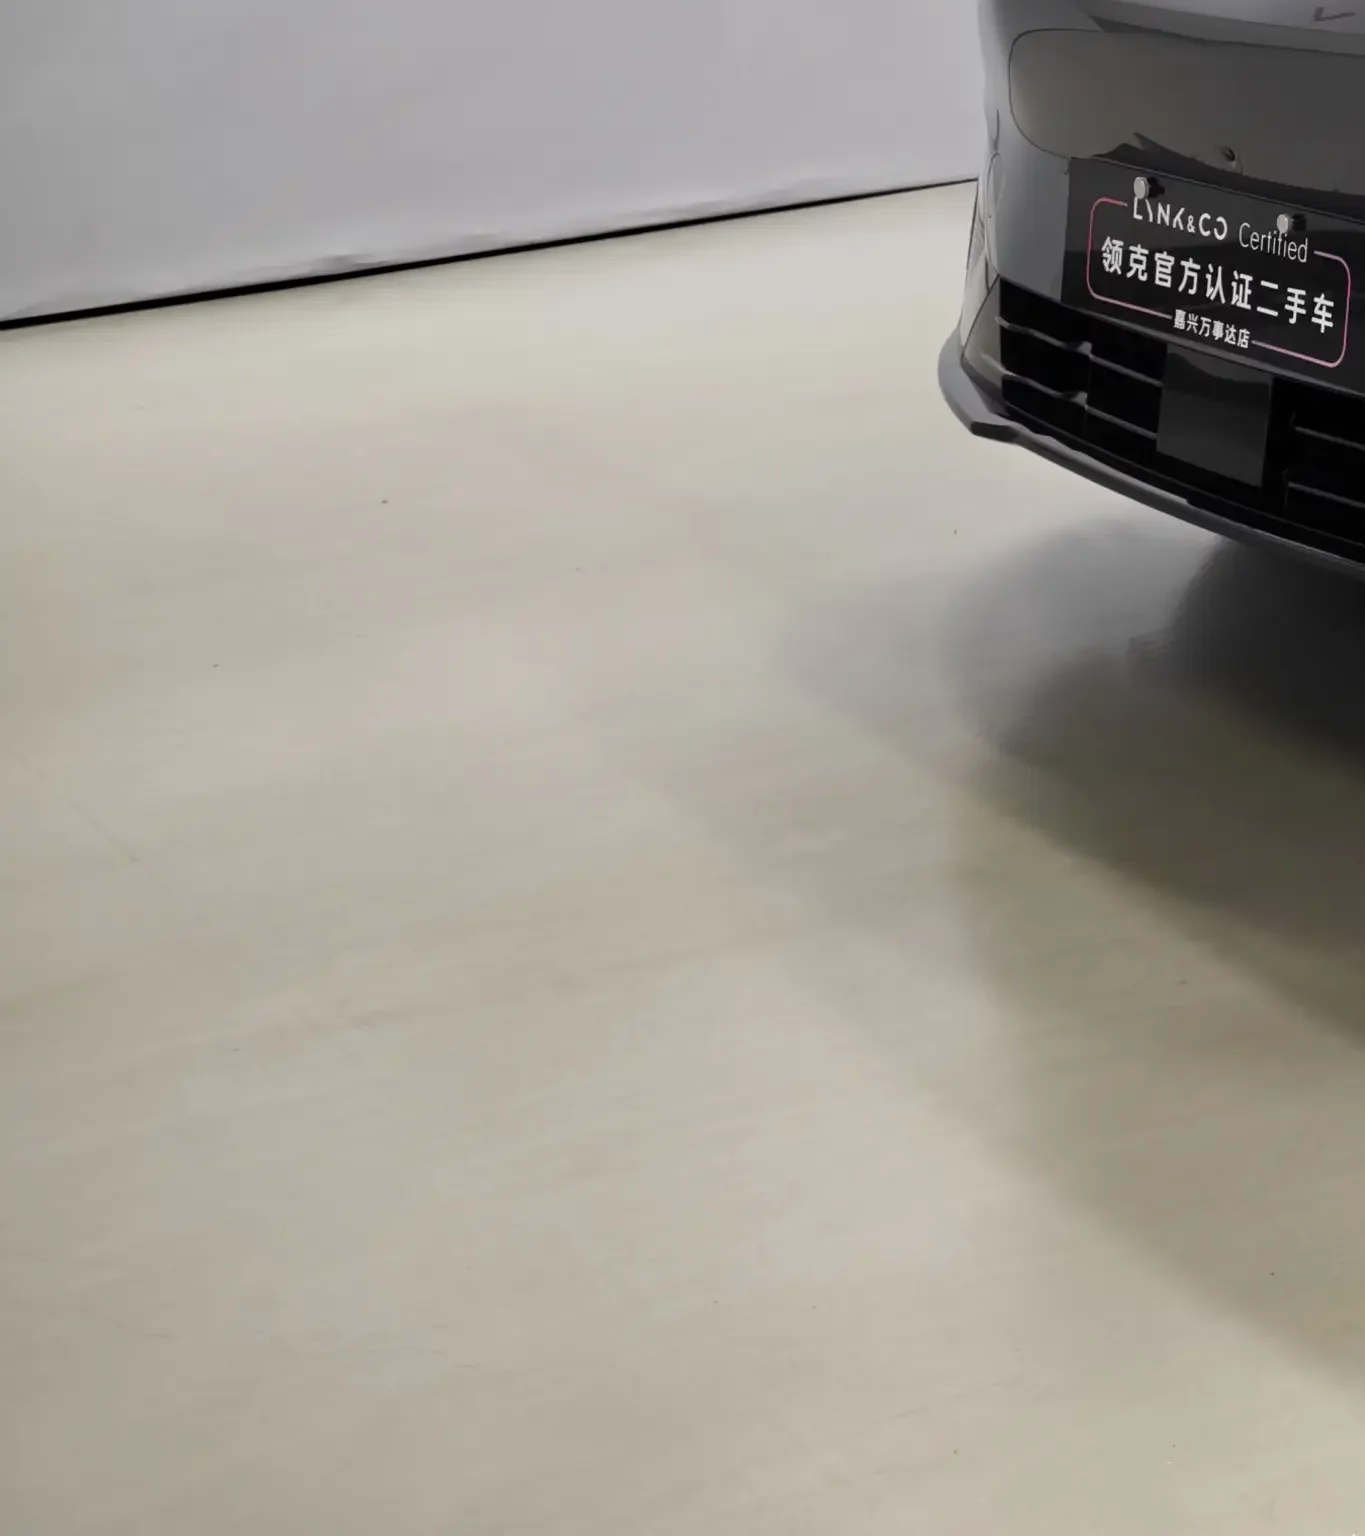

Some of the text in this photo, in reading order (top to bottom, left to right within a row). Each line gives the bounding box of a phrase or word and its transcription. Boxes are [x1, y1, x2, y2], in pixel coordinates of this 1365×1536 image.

[1238, 222, 1308, 263] Certified
[1101, 235, 1335, 334] 领克官方认证二手车
[1173, 309, 1250, 349] 嘉兴万事达店
